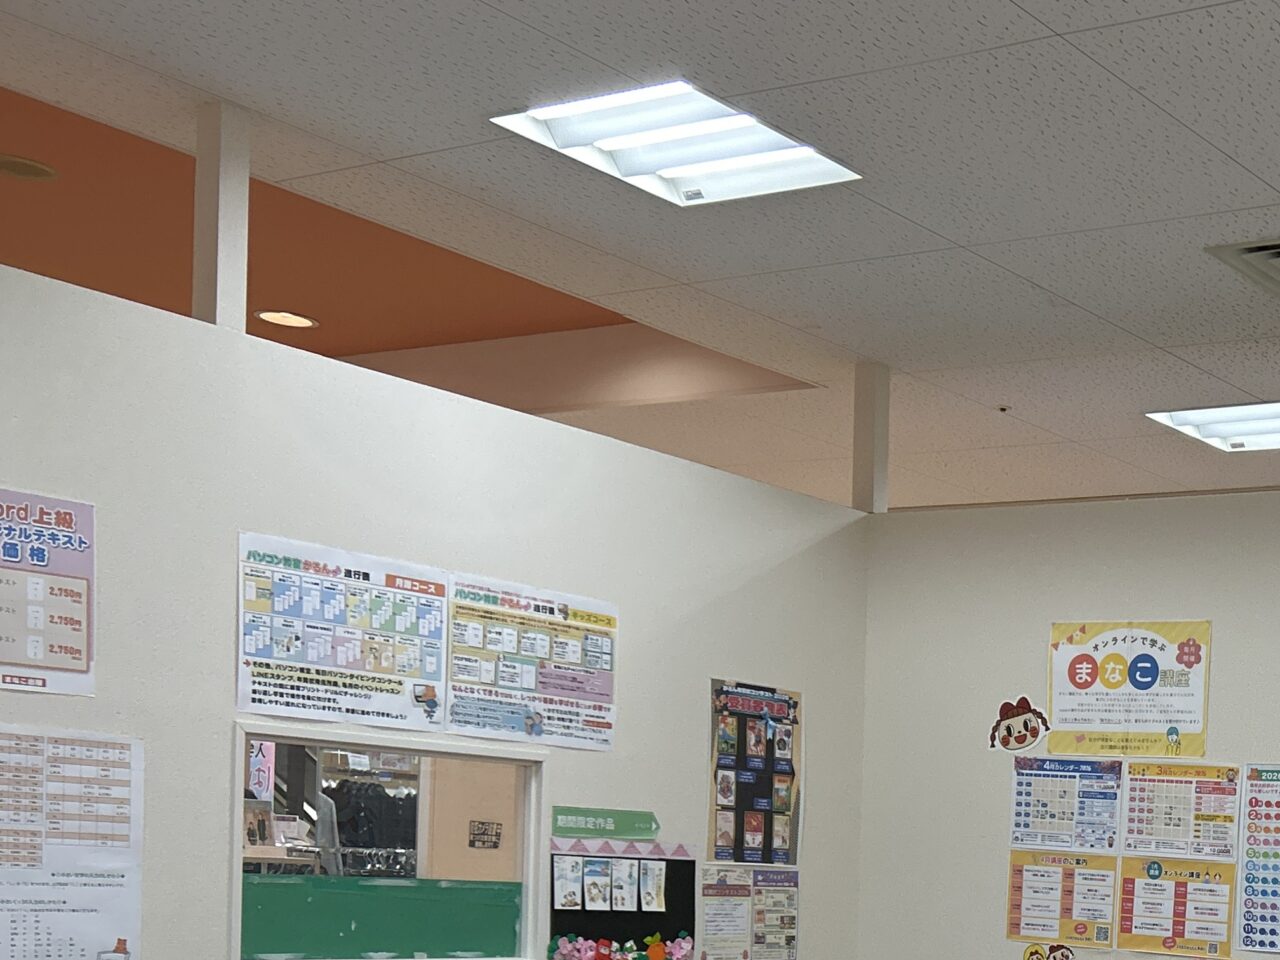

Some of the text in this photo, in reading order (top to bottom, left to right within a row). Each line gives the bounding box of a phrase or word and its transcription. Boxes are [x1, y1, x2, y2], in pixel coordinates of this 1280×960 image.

[33, 507, 75, 529] 上級
[1092, 635, 1167, 652] オンラインで学ぶ
[1075, 662, 1190, 688] まなこ 講座
